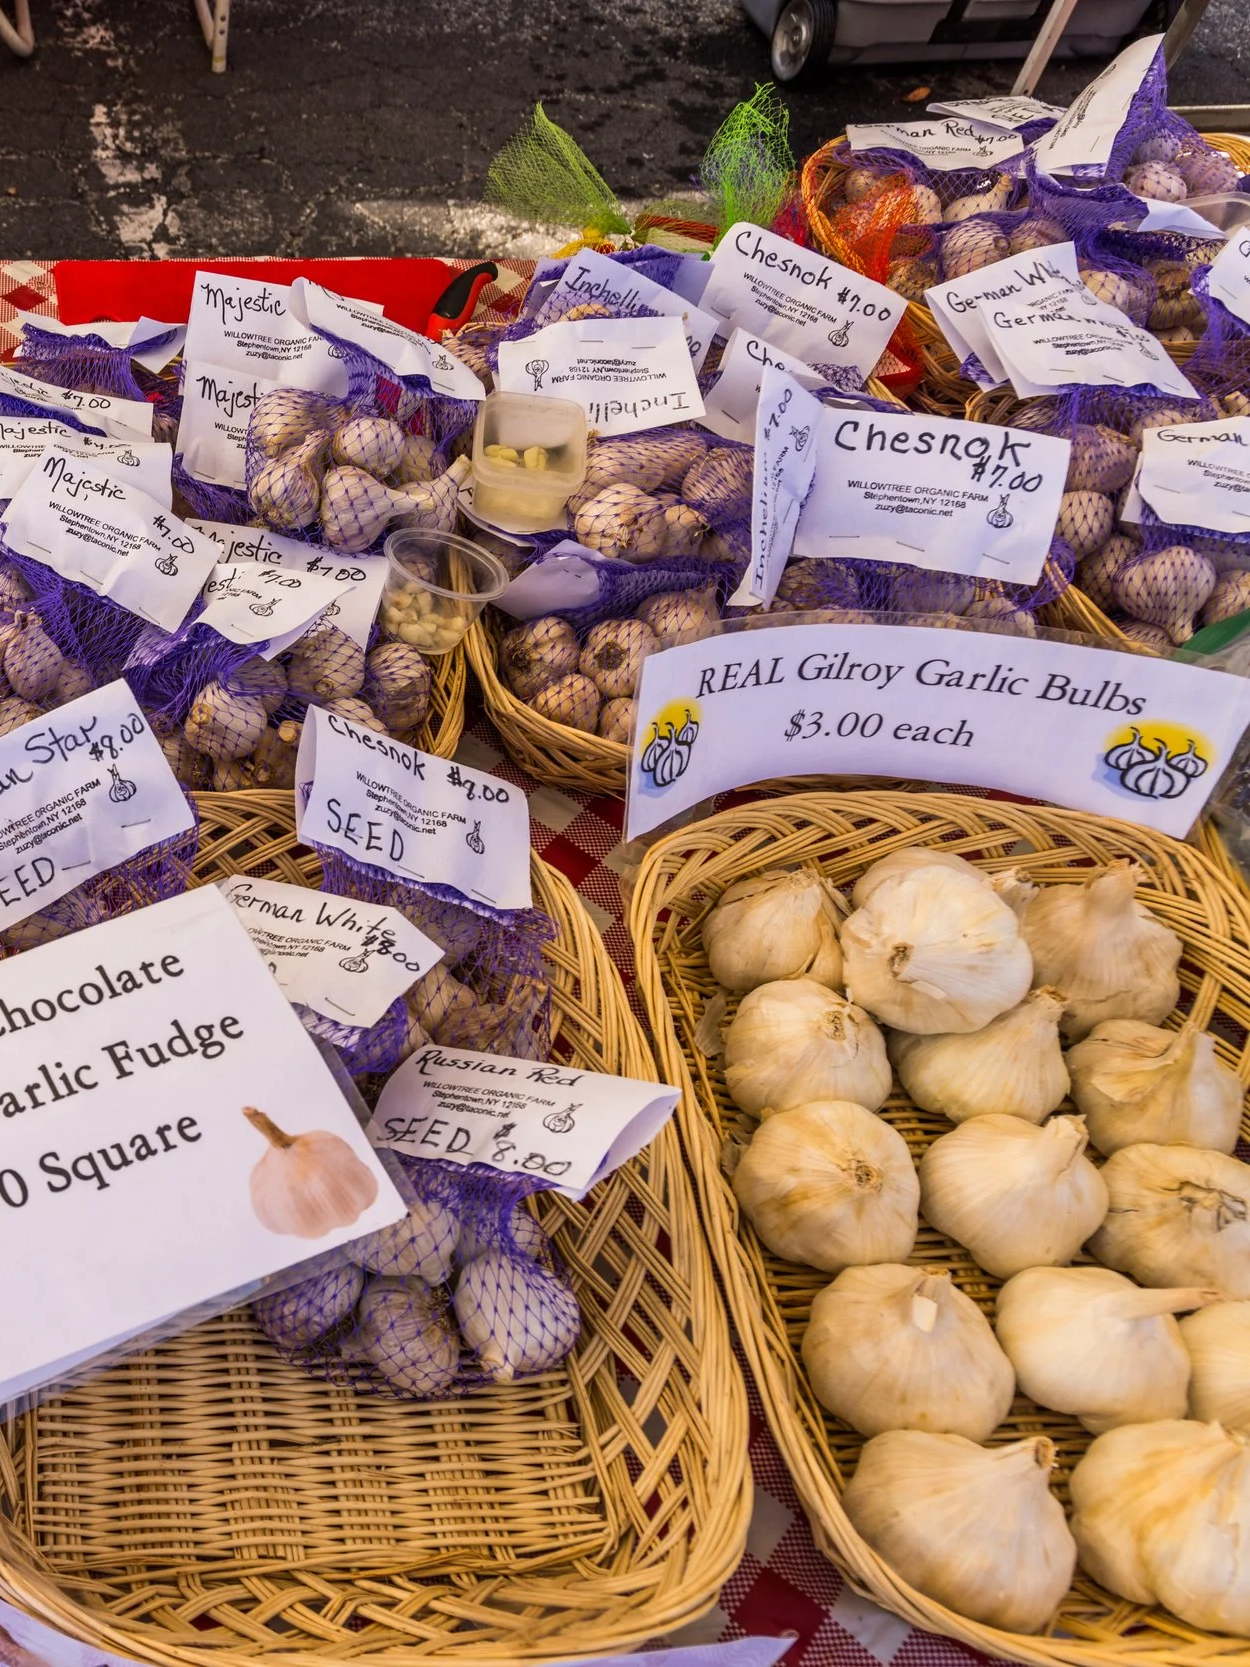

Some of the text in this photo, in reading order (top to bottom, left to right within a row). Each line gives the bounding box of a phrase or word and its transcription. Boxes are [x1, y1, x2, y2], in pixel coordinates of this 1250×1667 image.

[941, 119, 976, 138] Red
[735, 231, 892, 322] Chesnok $7.00
[200, 283, 287, 325] Majestic
[743, 272, 838, 324] WILLOWTREE ORGANIC FARM
[947, 284, 1023, 313] German
[755, 299, 806, 327] zuzy@taconic.net
[799, 311, 819, 324] 12168
[224, 330, 273, 343] WILLOWTREE
[274, 336, 307, 346] ORGANIC
[293, 344, 312, 352] 12168
[1033, 334, 1084, 345] WILLOWTREE
[246, 350, 303, 361] zuzy@taconic.net
[551, 373, 668, 384] WILLOWTREE ORGANIC FARM
[61, 390, 111, 409] $7.00
[214, 422, 251, 434] WILLOWT
[1158, 429, 1249, 447] German
[834, 420, 1043, 493] Chesnok $7.00
[1187, 459, 1246, 476] WILLOWTREE
[43, 456, 195, 554] Majestic $7.00
[848, 480, 989, 503] WILLOWTREE ORGANIC FARM
[863, 492, 967, 509] Stephentown,NY 12168
[875, 503, 954, 518] zuzy@taconic.net
[49, 500, 161, 552] WILLOWTREE ORGANIC FARM
[59, 515, 142, 550] Stephentown,NY 12168
[65, 527, 130, 557] zuzy@taconic.net
[258, 569, 302, 589] $7.00
[695, 651, 1148, 717] REAL Gilroy Garlic Bulbs
[25, 716, 98, 765] Star
[89, 712, 145, 762] $8.00
[782, 709, 976, 748] $3.00 each
[328, 714, 426, 781] Chesnok
[34, 793, 75, 824] ORGANIC
[74, 779, 101, 799] FARM
[61, 798, 87, 818] 12168
[356, 771, 467, 825] WILLOWTREE ORGANIC FARM
[15, 813, 83, 855] zuzy@taconic.net
[327, 798, 405, 862] SEED
[421, 817, 448, 828] 12168
[227, 884, 396, 940] German White
[285, 936, 351, 952] ORGANIC FARM
[102, 1009, 246, 1080] Fudge
[415, 1050, 585, 1087] Russian Red
[423, 1080, 557, 1108] WILLOWTREE ORGANIC FARM
[432, 1090, 528, 1110] Stephentown,NY 12168
[377, 1116, 474, 1157] SEED
[38, 1110, 203, 1194] Square
